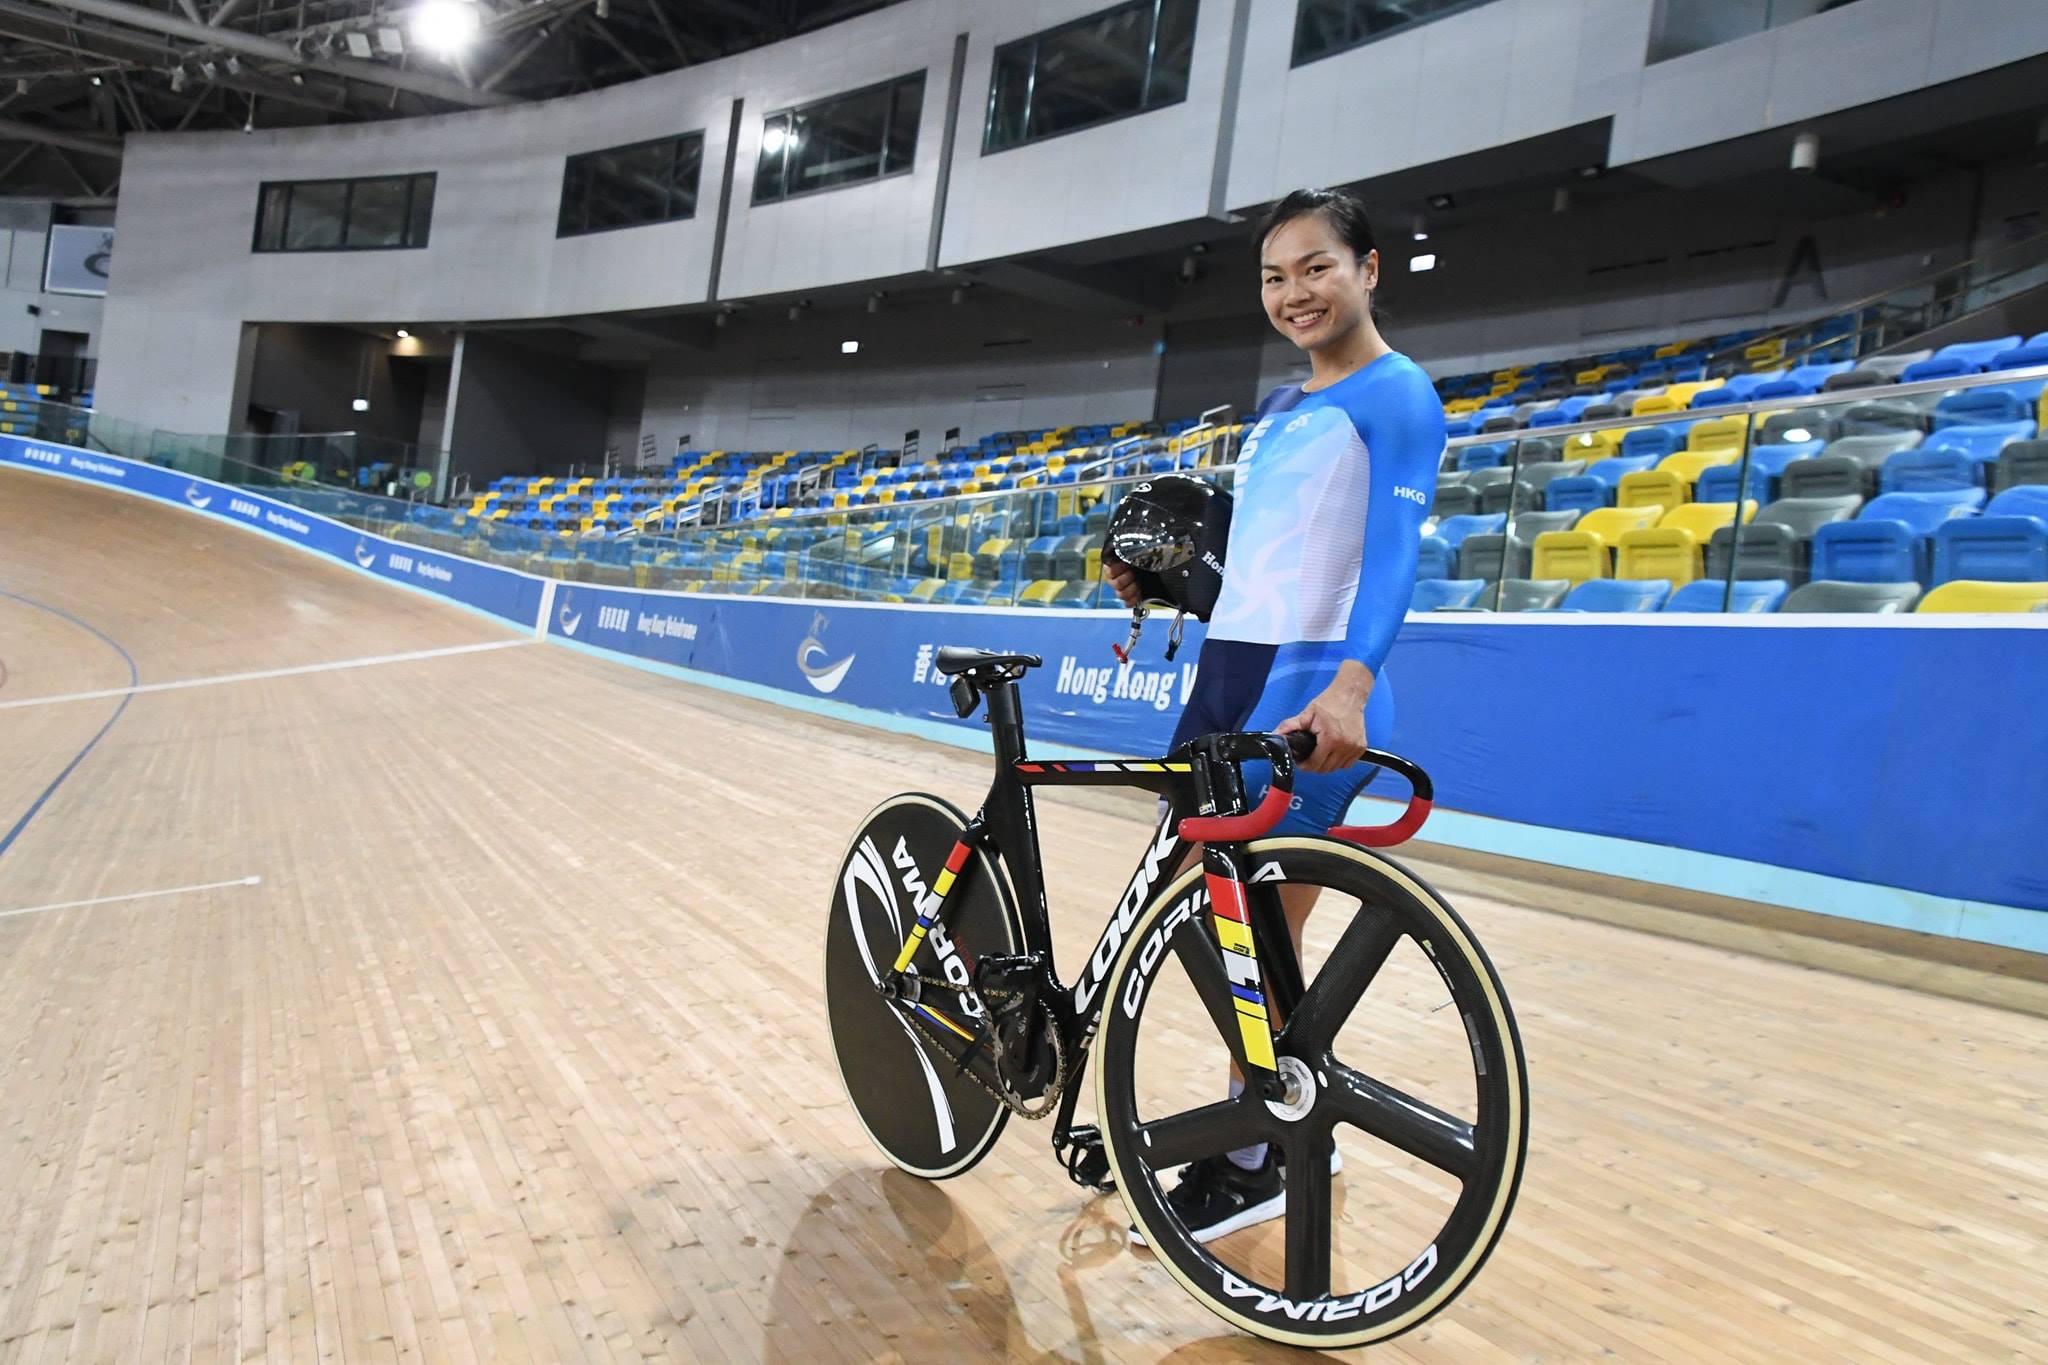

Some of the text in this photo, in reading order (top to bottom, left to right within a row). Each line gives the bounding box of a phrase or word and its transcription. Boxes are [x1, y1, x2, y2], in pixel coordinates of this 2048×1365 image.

[1393, 485, 1426, 505] HKG
[1201, 550, 1225, 577] Hon
[1056, 655, 1113, 704] Hong
[1112, 659, 1177, 711] Kong
[1258, 784, 1304, 811] HG
[891, 834, 985, 1020] CORMA
[1075, 807, 1180, 1015] LOOK
[1123, 861, 1287, 1019] CORIA
[1222, 1242, 1438, 1322] CORIMA
